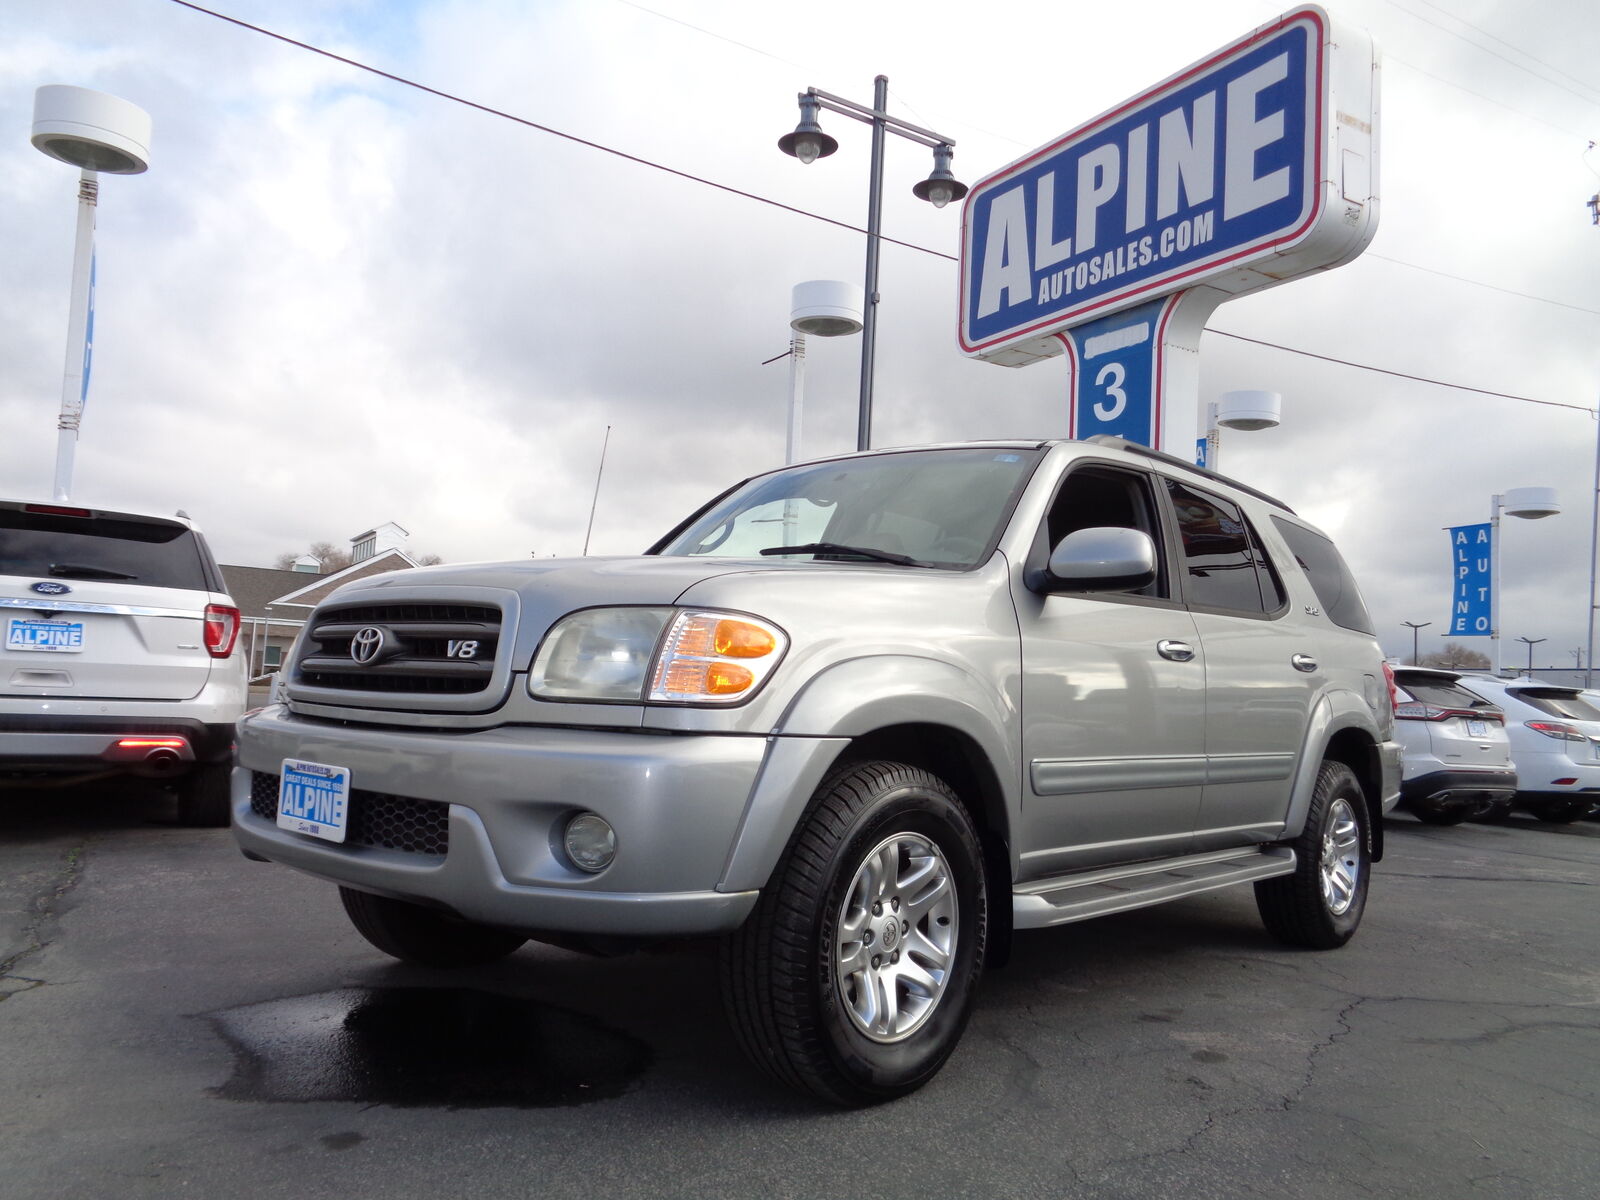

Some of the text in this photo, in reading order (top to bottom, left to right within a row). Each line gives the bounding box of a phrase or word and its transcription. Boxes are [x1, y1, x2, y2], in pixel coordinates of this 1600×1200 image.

[977, 51, 1290, 319] ALPINE
[1038, 211, 1213, 305] AUTOSALES.COM
[1093, 362, 1126, 421] 3
[37, 583, 63, 593] Ford
[1456, 531, 1469, 631] ALPINE
[1475, 529, 1488, 631] AUTO
[11, 628, 81, 646] ALPINE
[447, 640, 478, 658] V8
[282, 783, 343, 827] ALPINE
